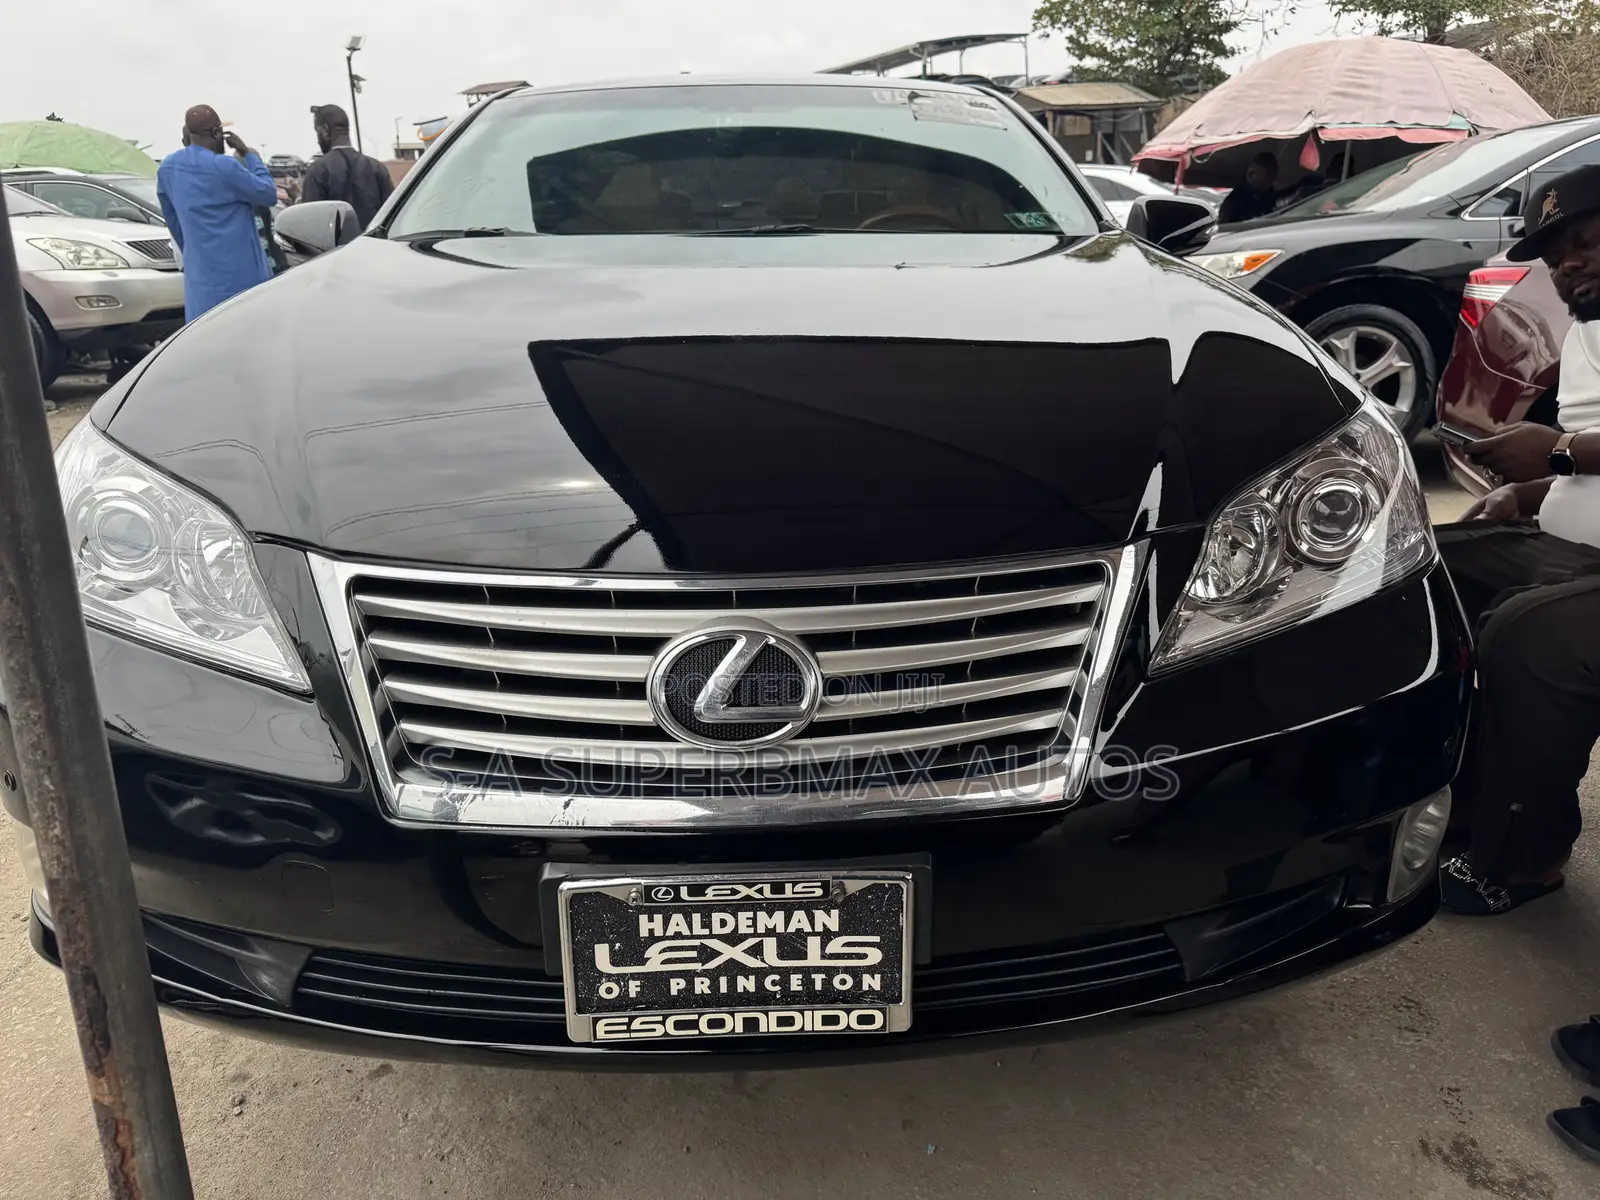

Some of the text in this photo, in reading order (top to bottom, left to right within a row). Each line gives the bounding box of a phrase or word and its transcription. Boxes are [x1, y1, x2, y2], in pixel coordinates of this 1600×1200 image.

[679, 882, 824, 901] LEXUS
[638, 909, 840, 938] HALDEMAN
[594, 935, 884, 974] LEXUS
[598, 973, 882, 999] OF PRINCETON
[595, 1008, 885, 1040] ESCONDIDO
